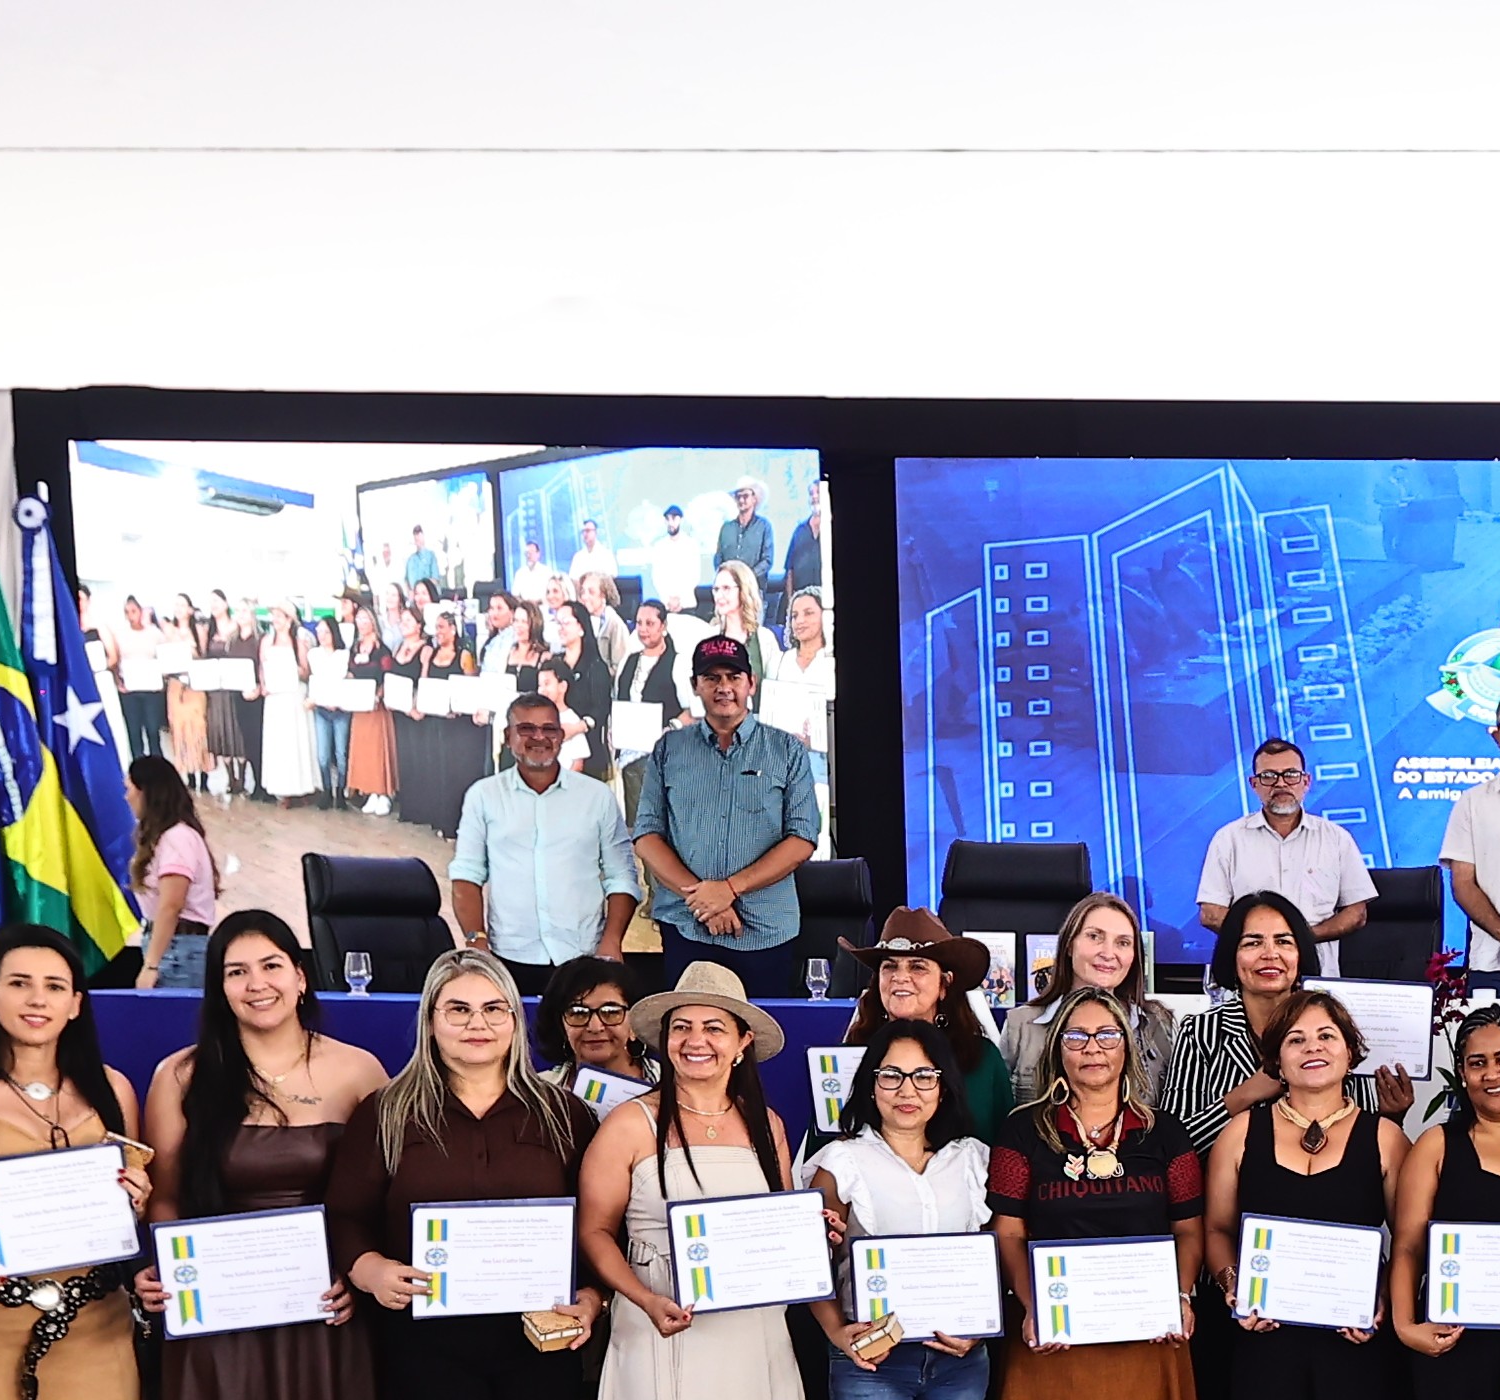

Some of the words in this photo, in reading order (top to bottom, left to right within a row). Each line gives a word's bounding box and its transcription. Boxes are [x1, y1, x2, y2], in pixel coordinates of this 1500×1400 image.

[1393, 770, 1422, 784] DO
[1398, 787, 1413, 799] A
[1417, 787, 1461, 801] amig
[1038, 1176, 1164, 1201] CHIQUITANO
